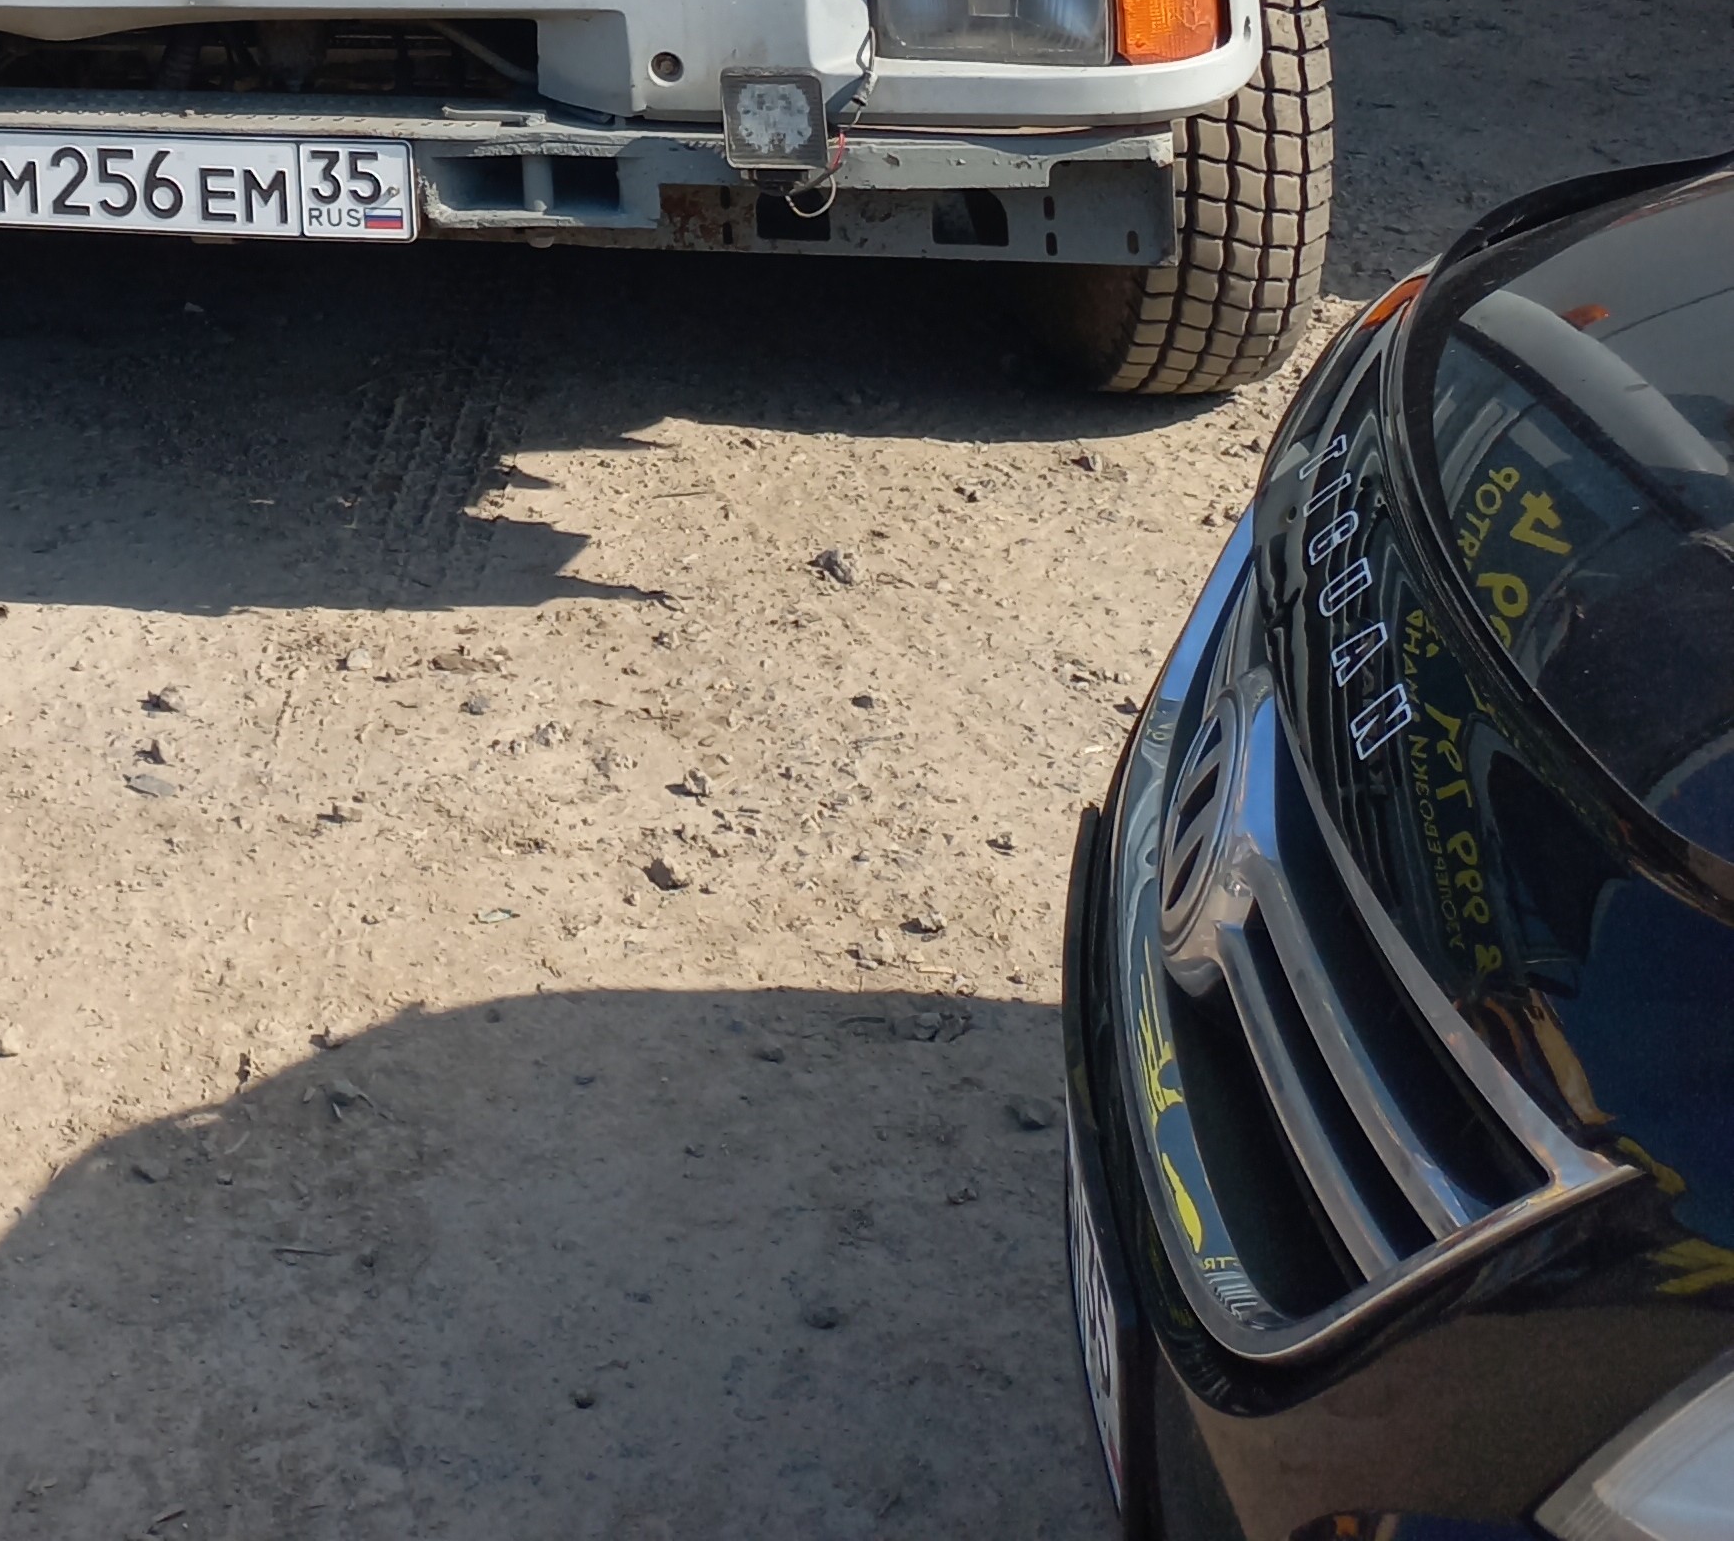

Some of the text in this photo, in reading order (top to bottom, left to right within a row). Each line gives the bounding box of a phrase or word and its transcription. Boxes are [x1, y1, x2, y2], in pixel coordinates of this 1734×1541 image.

[308, 150, 383, 205] 35
[308, 207, 361, 227] RUS
[1299, 434, 1412, 761] TIGUAN
